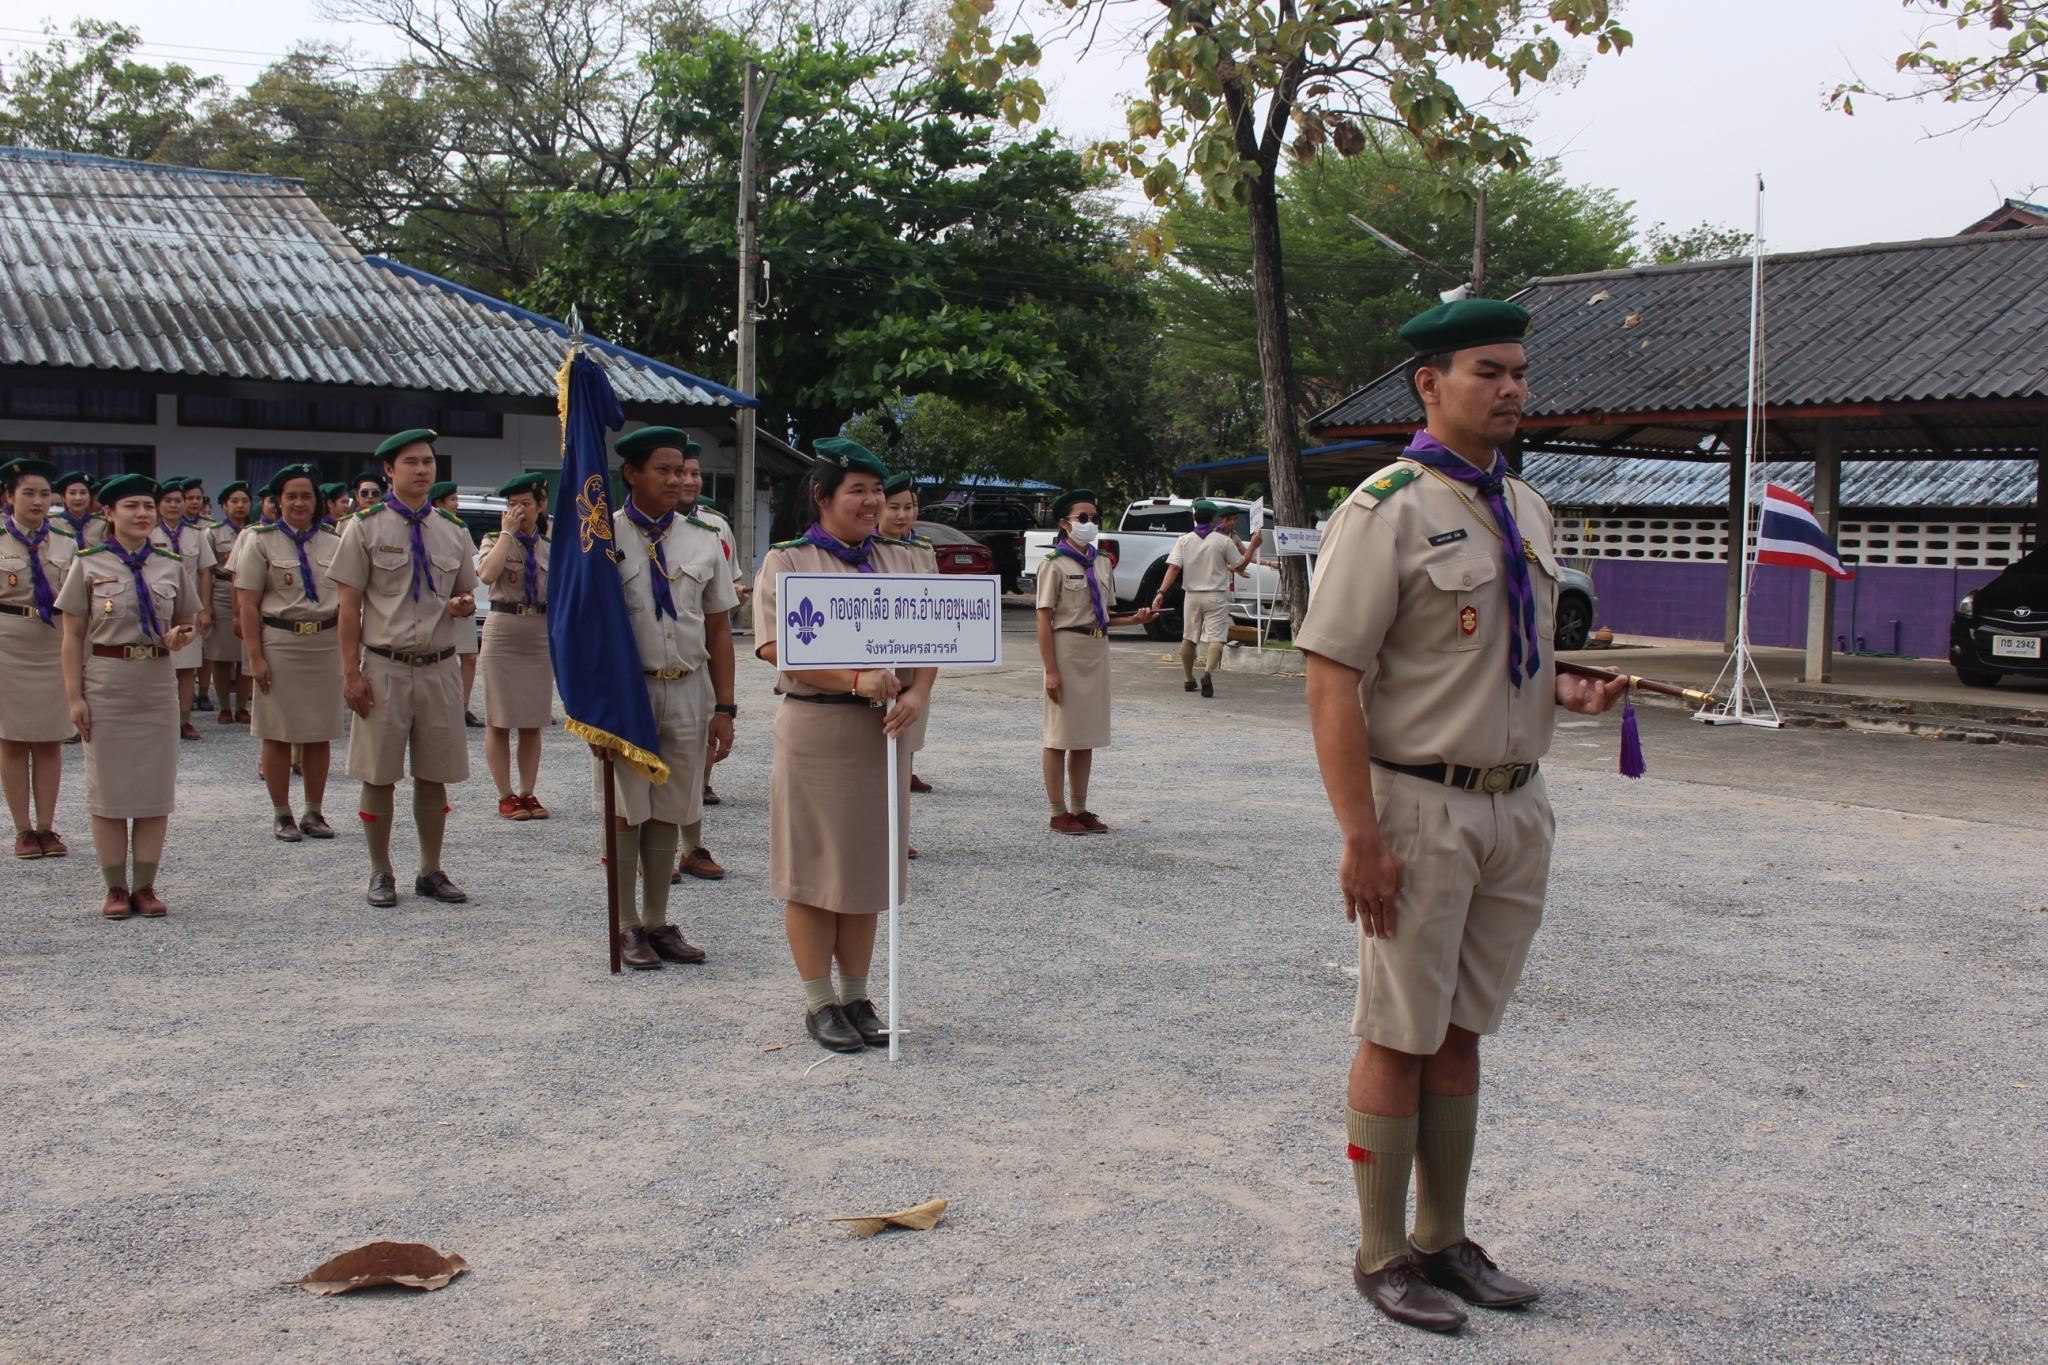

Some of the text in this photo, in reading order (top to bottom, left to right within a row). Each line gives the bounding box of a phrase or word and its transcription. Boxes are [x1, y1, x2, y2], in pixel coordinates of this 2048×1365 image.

[829, 587, 991, 632] กองลูกเสือ สกร.อำเภอชุมแสง
[865, 638, 958, 655] จังหวัดนครสวรรค์
[2016, 640, 2036, 649] 2942
